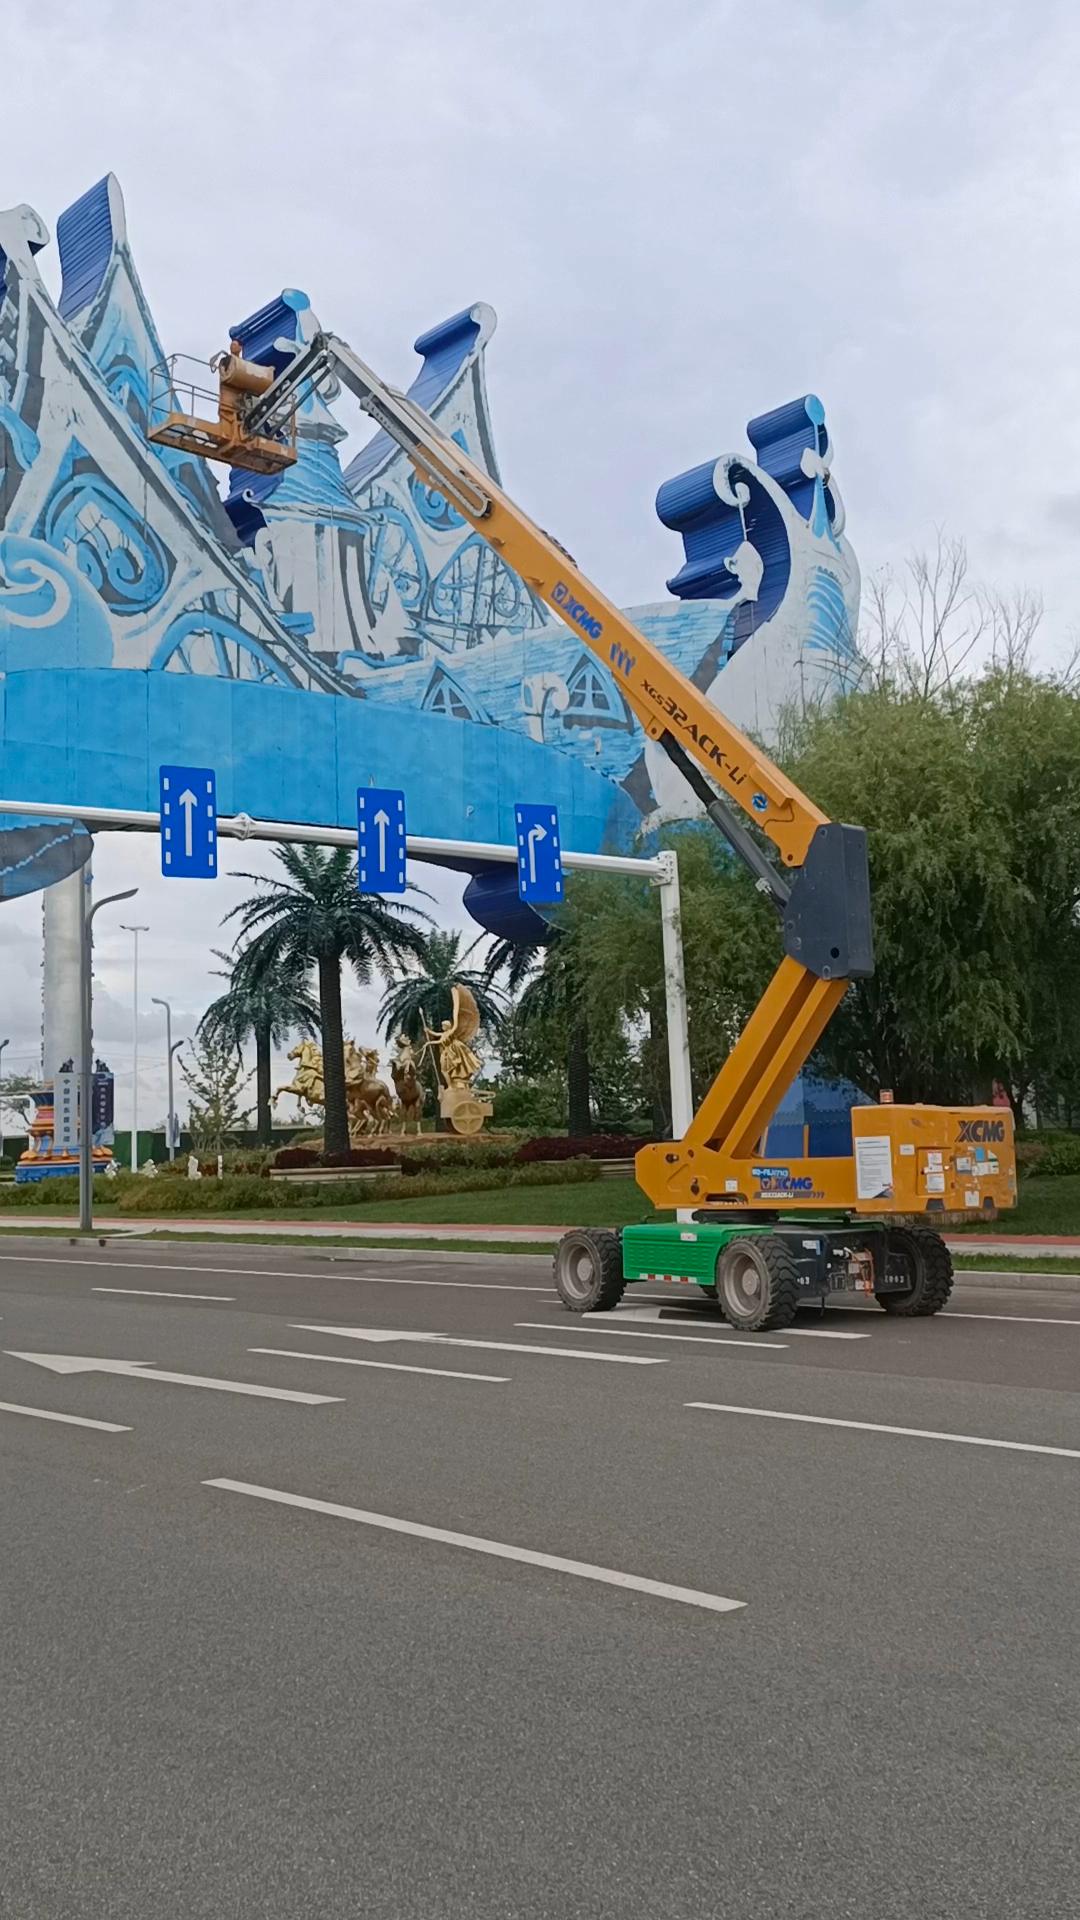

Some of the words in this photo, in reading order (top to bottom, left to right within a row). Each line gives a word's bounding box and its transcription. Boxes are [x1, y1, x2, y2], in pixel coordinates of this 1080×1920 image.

[562, 595, 603, 639] XCMG
[954, 1120, 1005, 1142] XCMG
[771, 1177, 813, 1190] XCMG
